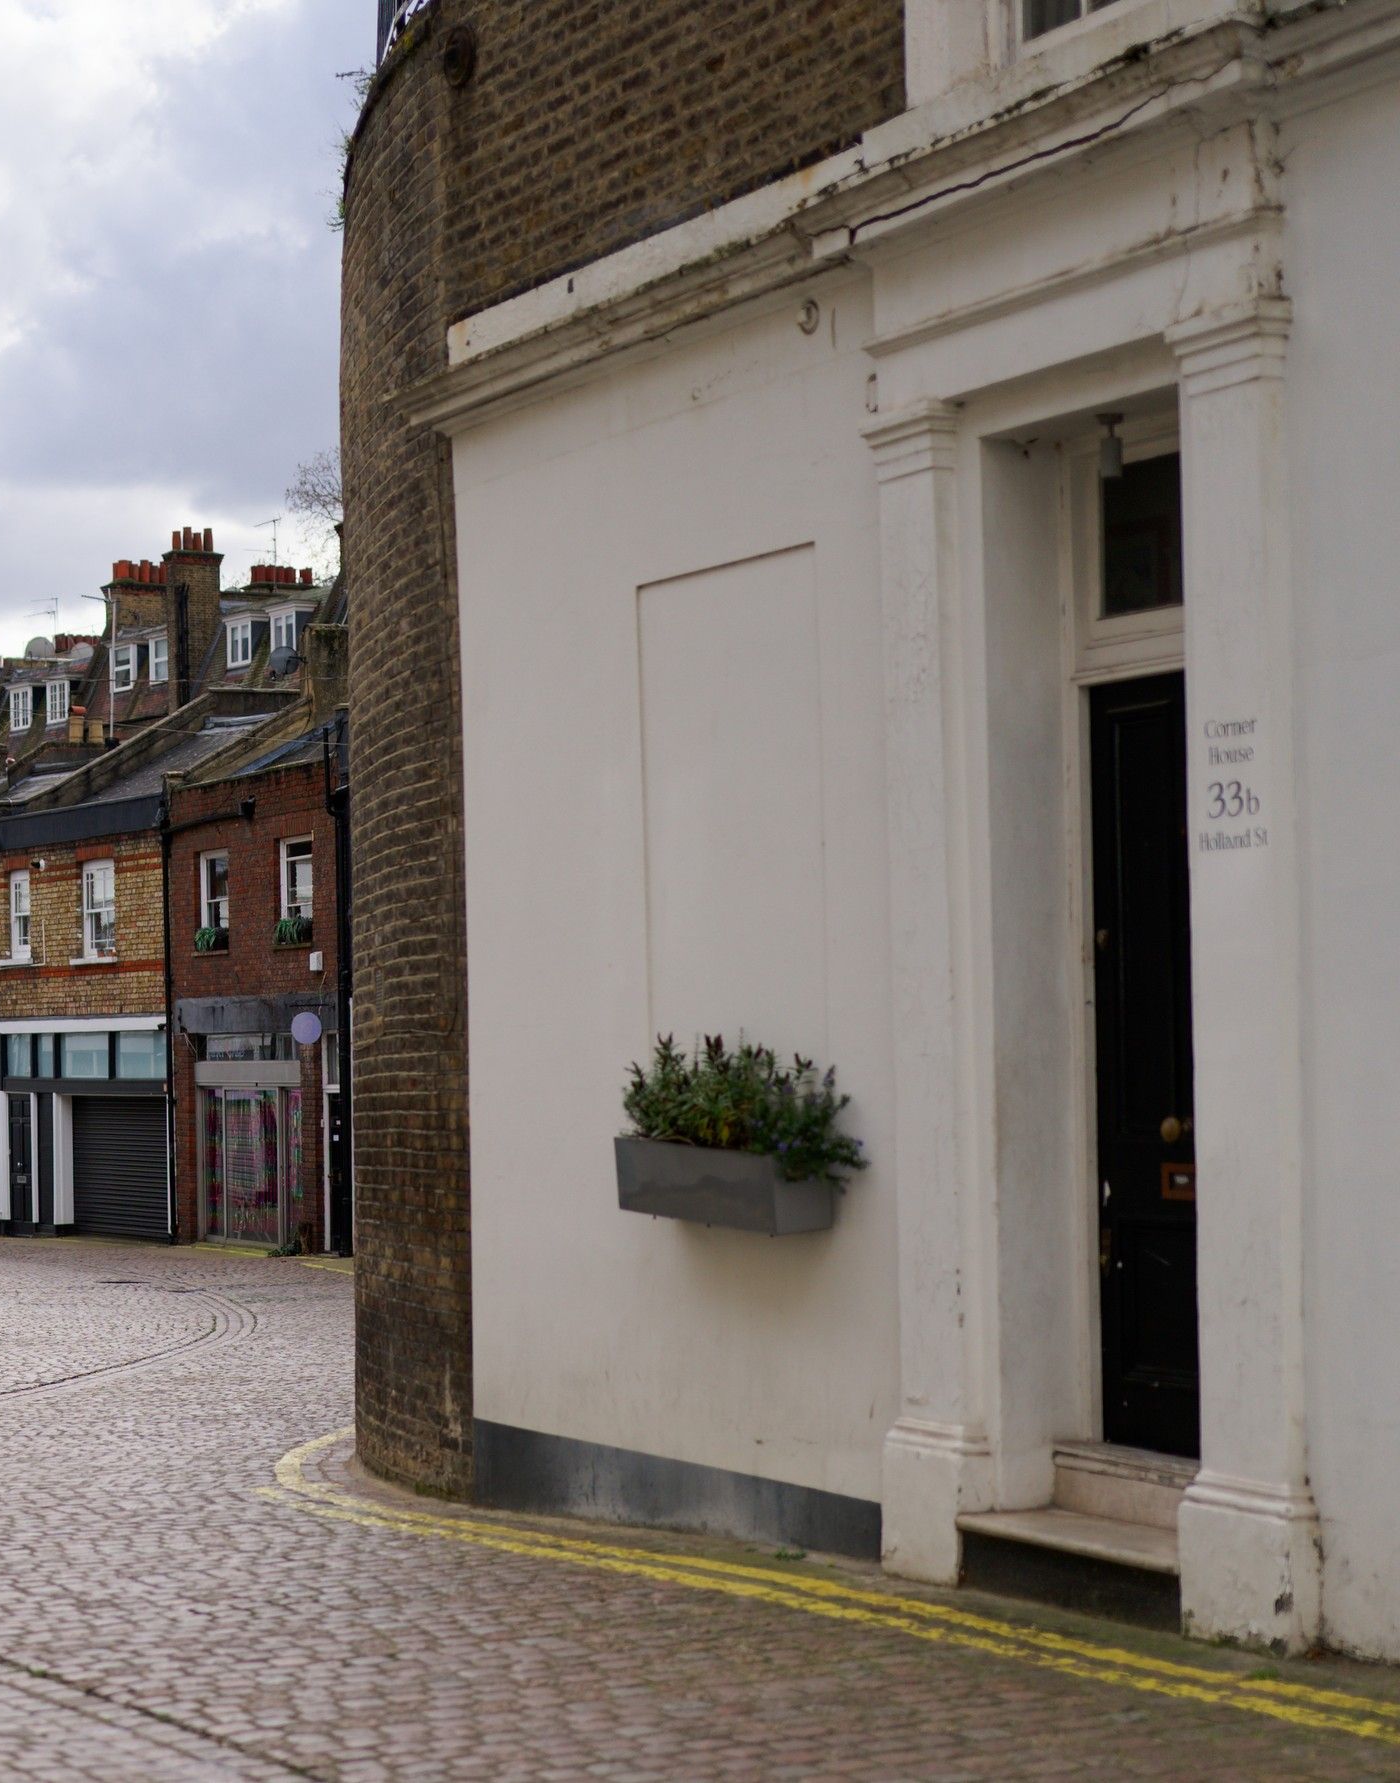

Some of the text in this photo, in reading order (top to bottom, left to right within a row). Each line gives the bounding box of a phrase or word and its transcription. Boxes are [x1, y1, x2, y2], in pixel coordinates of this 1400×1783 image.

[1203, 718, 1257, 739] Corner
[1208, 746, 1255, 766] House
[1207, 780, 1261, 819] 33b
[1199, 826, 1269, 852] Holland St
